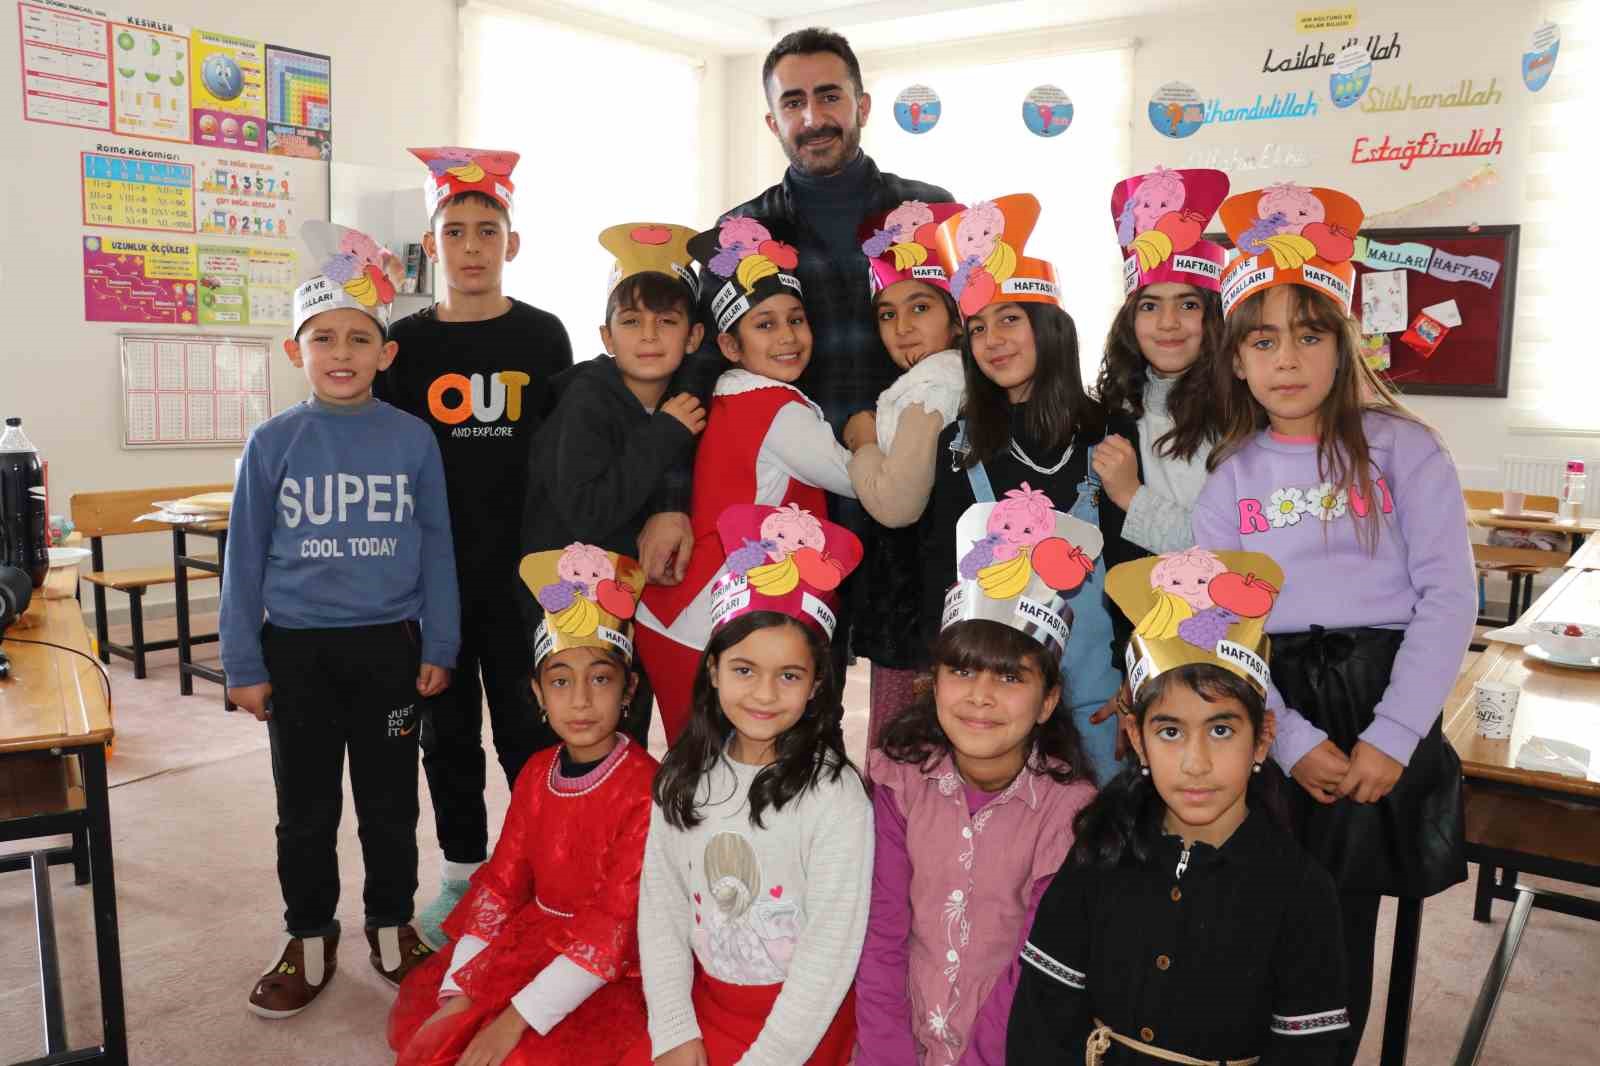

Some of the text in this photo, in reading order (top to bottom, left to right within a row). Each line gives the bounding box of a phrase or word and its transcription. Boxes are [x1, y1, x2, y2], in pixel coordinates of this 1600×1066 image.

[127, 16, 174, 32] KESİRLER
[1262, 42, 1336, 73] Lailahe
[96, 144, 126, 155] Roma
[243, 176, 252, 190] 3
[256, 176, 264, 191] 5
[267, 178, 275, 193] 7
[241, 215, 250, 229] 2
[254, 216, 262, 230] 4
[1176, 259, 1216, 273] HAFTASI
[1367, 248, 1494, 283] MALLARI HAFTASI
[913, 269, 944, 278] HAFTA
[313, 280, 326, 290] VE
[427, 370, 530, 425] OUT
[451, 426, 513, 439] AND EXPLORE
[301, 537, 398, 558] COOL TODAY
[734, 576, 745, 587] VE
[1019, 601, 1060, 631] HAFTASI
[1221, 644, 1263, 676] HAFTASI
[388, 719, 404, 727] DO
[388, 728, 401, 737] IT
